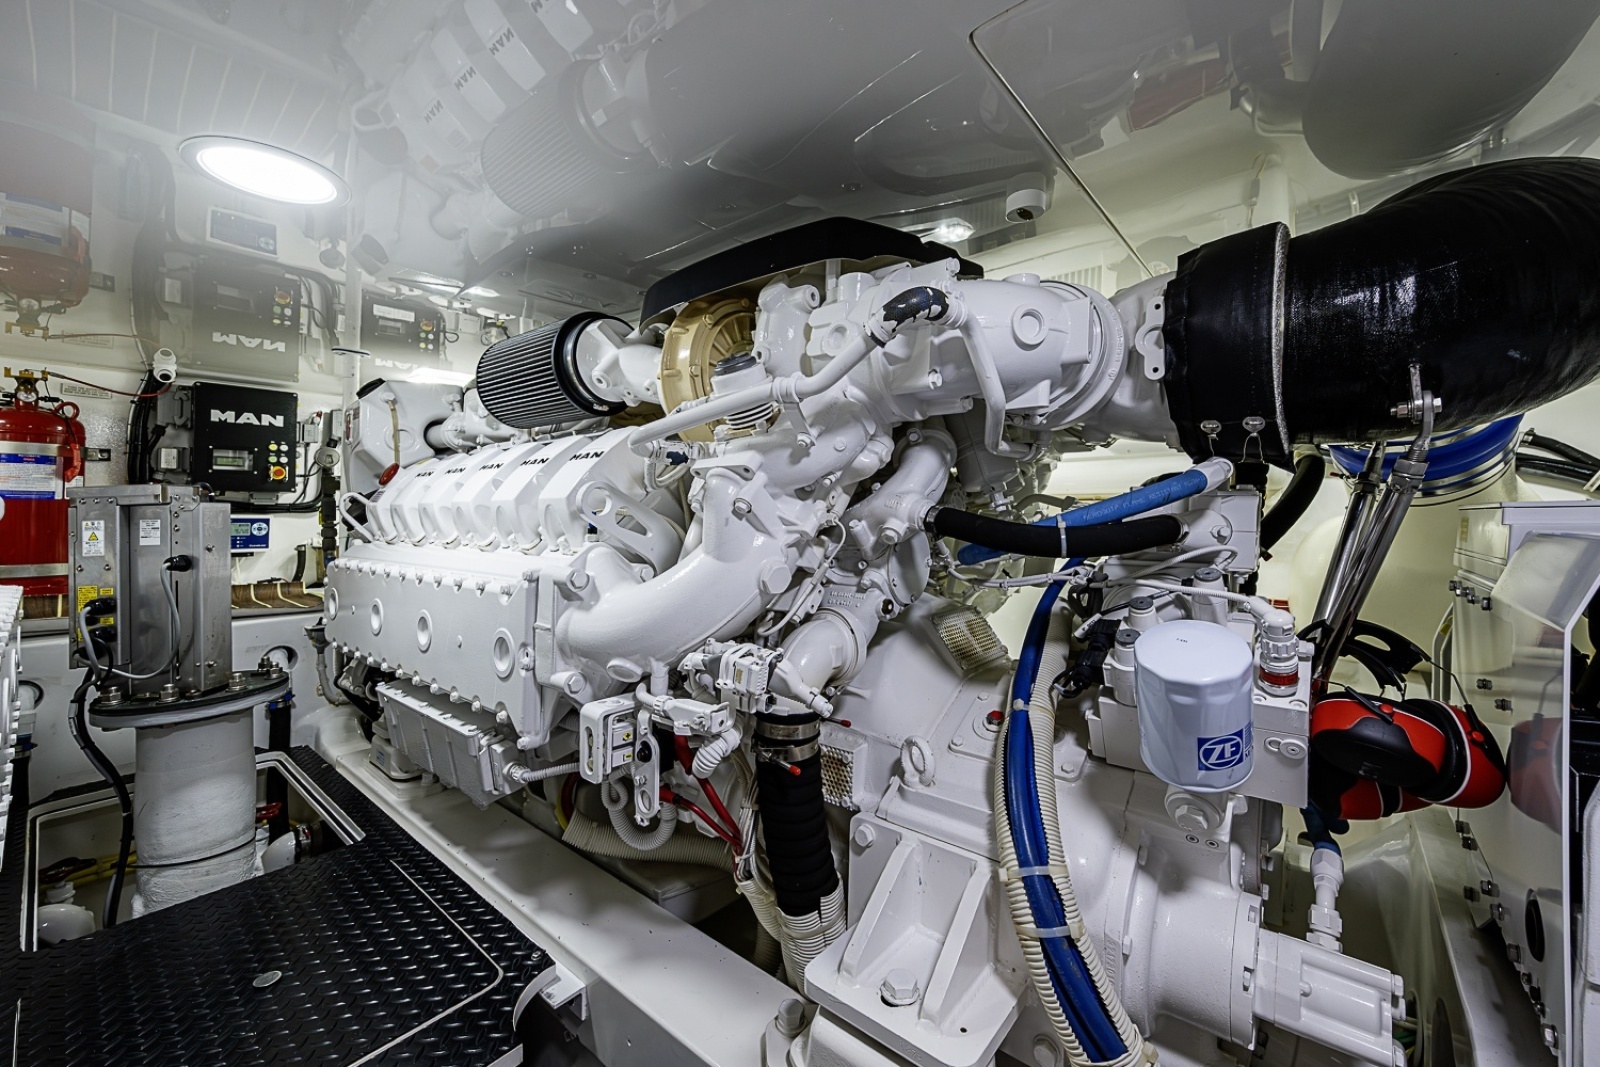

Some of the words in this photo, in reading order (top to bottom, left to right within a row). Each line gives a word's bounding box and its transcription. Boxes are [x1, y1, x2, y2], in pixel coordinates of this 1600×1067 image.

[210, 409, 285, 428] MAN
[569, 450, 605, 462] MAN
[478, 462, 505, 472] MAN
[520, 457, 550, 467] MAN
[414, 470, 435, 479] MAN
[445, 466, 467, 475] MAN
[1122, 496, 1145, 509] FLAME
[1200, 738, 1241, 766] ZF
